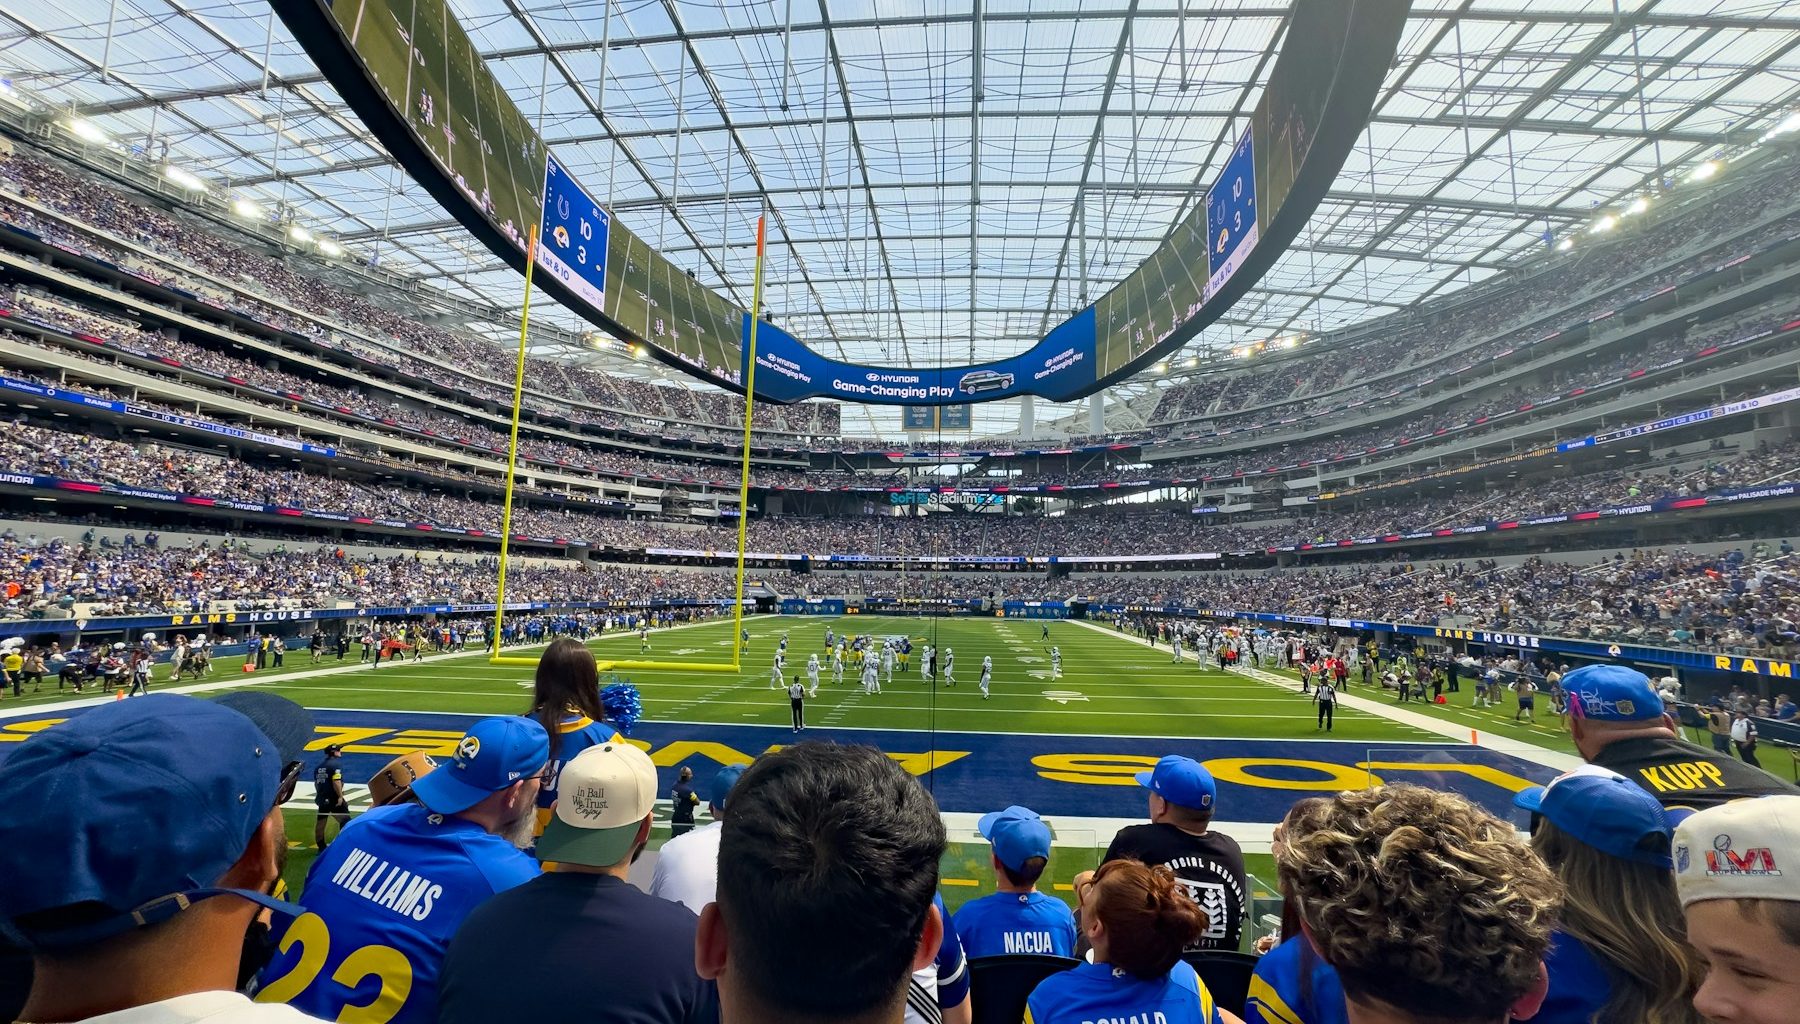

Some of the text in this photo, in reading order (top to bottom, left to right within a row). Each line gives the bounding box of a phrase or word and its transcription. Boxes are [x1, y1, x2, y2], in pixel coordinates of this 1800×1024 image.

[1232, 176, 1242, 202] 10
[580, 217, 592, 241] 10
[1234, 211, 1241, 232] 3
[577, 245, 587, 264] 3
[542, 252, 570, 281] 1st & 10
[1212, 277, 1220, 290] 1st
[1225, 262, 1232, 274] 10
[755, 356, 812, 383] Game-Changing Play
[776, 357, 800, 371] HYUNDAI
[1034, 352, 1083, 379] Game-Changing Play
[881, 375, 919, 383] HYUNDAI
[833, 379, 954, 398] Game-Changing Play
[84, 397, 112, 408] RAMS
[1728, 405, 1739, 413] 1st
[161, 414, 170, 422] 10
[132, 490, 158, 499] PALISADE
[158, 493, 177, 501] Hybrid
[890, 492, 977, 504] SoFi Stadium
[1738, 490, 1770, 500] PALISADE
[1770, 486, 1794, 496] Hybrid
[234, 503, 264, 512] HYUNDAI
[1618, 505, 1652, 515] HYUNDAI
[172, 611, 312, 625] RAMS HOUSE
[1435, 628, 1540, 647] RAMS HOUSE
[1715, 655, 1792, 678] RAM
[1639, 761, 1726, 792] KUPP
[577, 786, 604, 798] In Ball
[572, 796, 584, 808] We
[575, 807, 602, 820] Enjoy
[332, 847, 443, 921] WILLIAMS
[1003, 931, 1053, 954] NACUA
